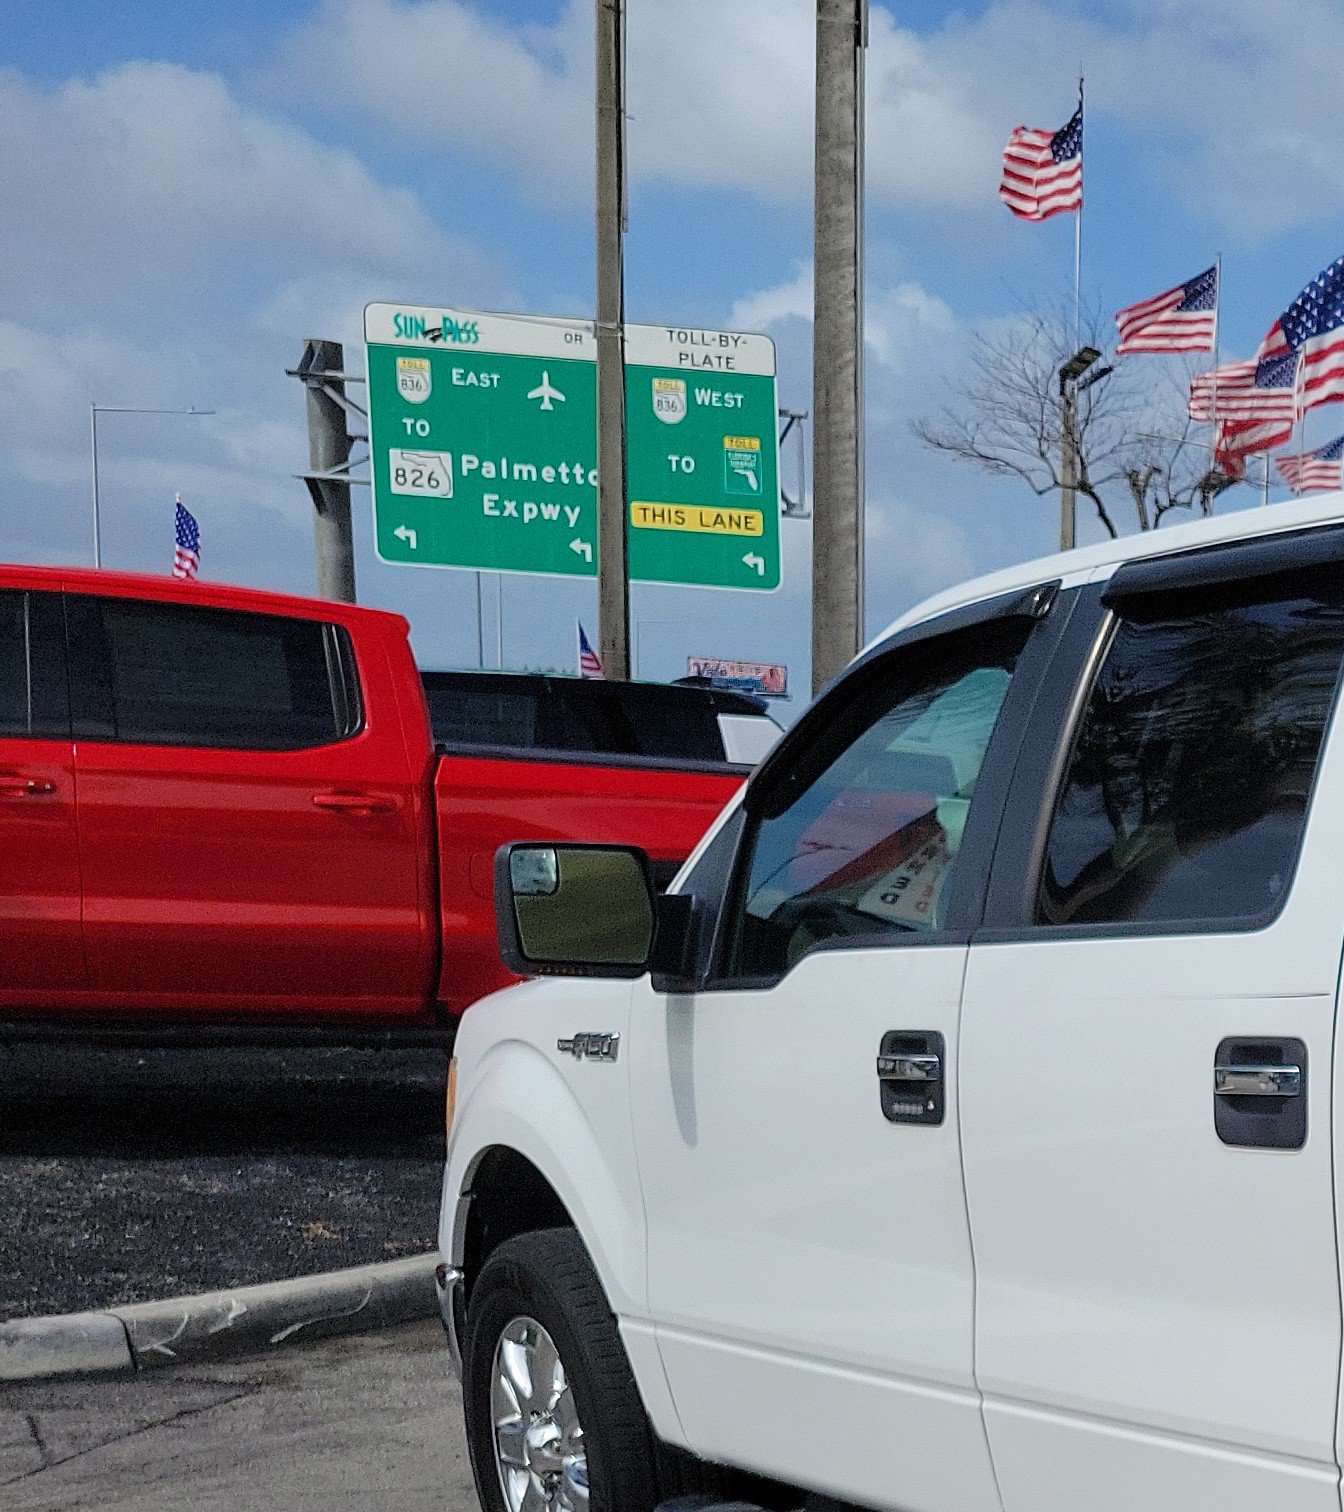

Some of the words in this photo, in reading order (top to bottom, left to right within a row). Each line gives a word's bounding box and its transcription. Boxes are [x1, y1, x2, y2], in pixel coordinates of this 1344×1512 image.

[393, 313, 425, 341] SUN
[441, 316, 480, 344] PASS
[564, 333, 583, 345] OR
[667, 330, 747, 348] TOLL-BY-
[679, 352, 735, 370] PLATE
[452, 367, 500, 388] EAST
[694, 387, 744, 408] WEST
[402, 418, 430, 437] TO
[667, 453, 696, 474] TO
[394, 467, 440, 489] 826
[483, 493, 581, 527] Expwy
[639, 507, 686, 526] THIS
[700, 511, 757, 531] LANE
